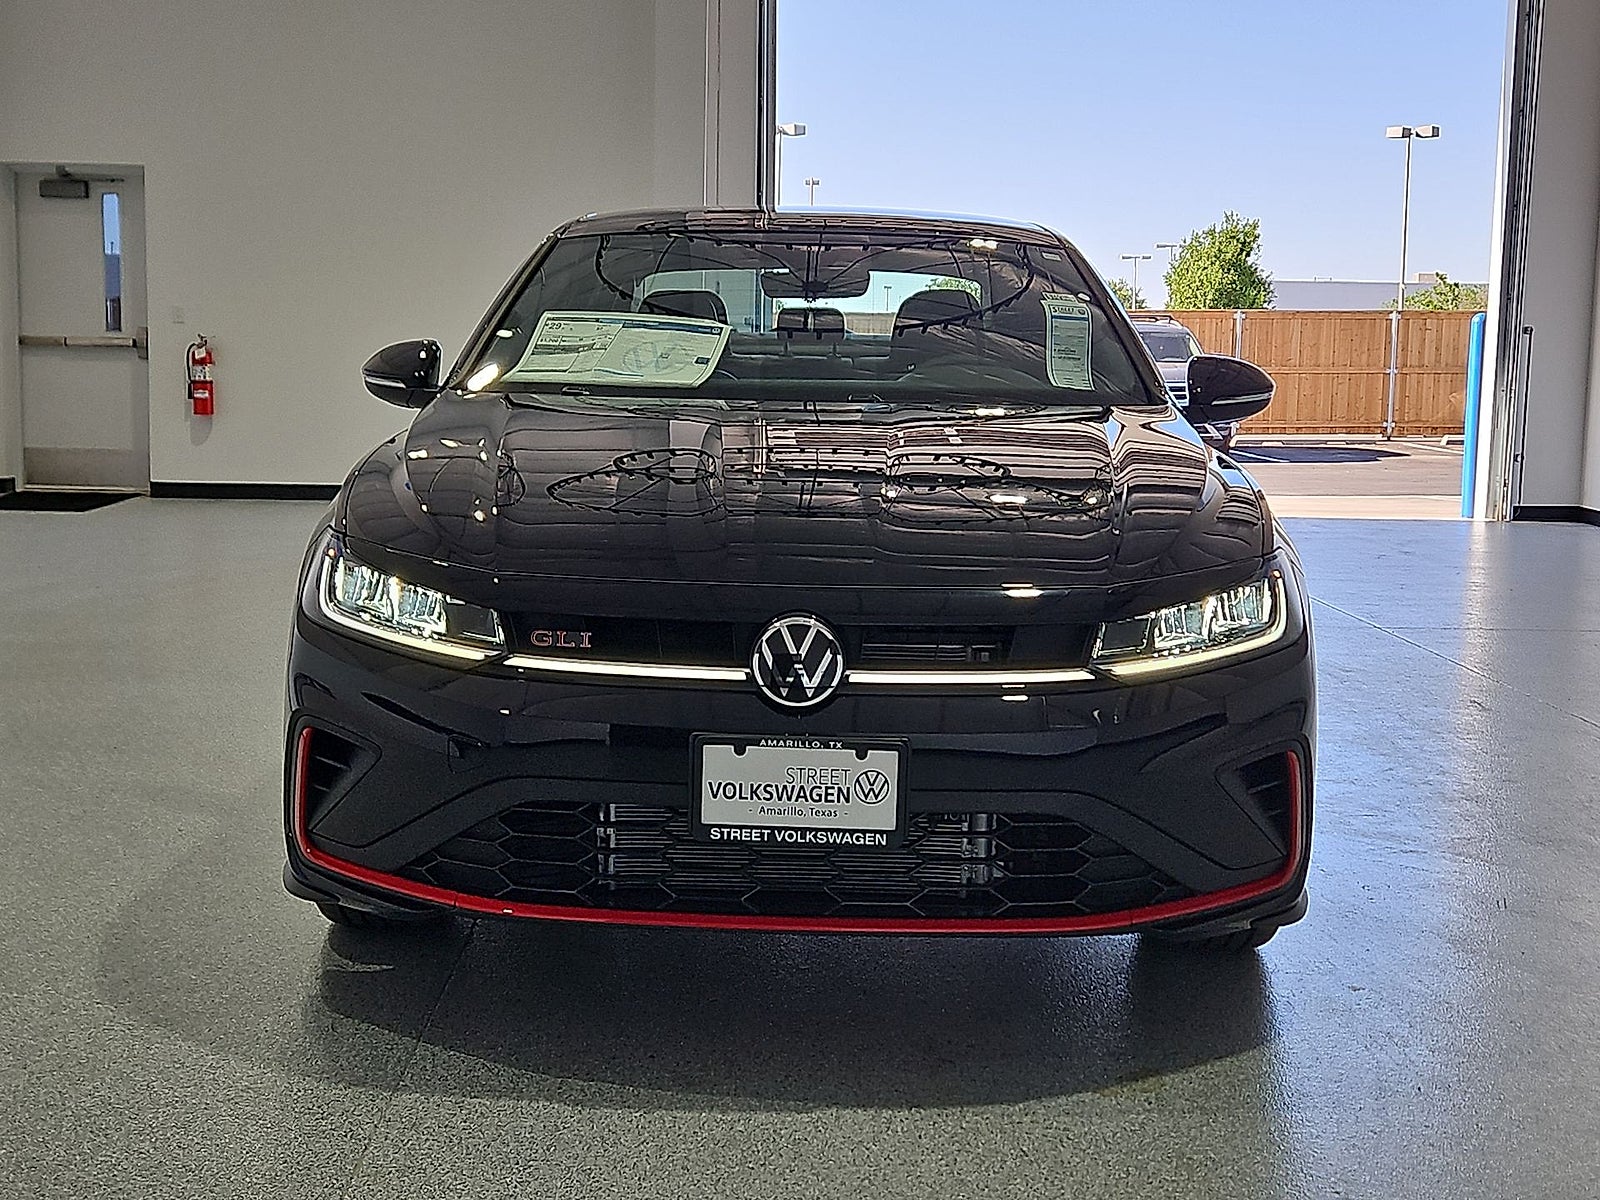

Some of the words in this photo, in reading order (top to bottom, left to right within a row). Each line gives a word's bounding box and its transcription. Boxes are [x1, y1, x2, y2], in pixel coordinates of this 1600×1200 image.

[530, 629, 592, 648] GLI
[828, 741, 843, 749] TX
[785, 767, 851, 785] STREET
[708, 781, 851, 803] VOLKSWAGEN
[758, 805, 807, 817] Amarillo,
[808, 807, 838, 818] Texas
[710, 828, 772, 841] STREET
[774, 829, 887, 845] VOLKSWAGEN
